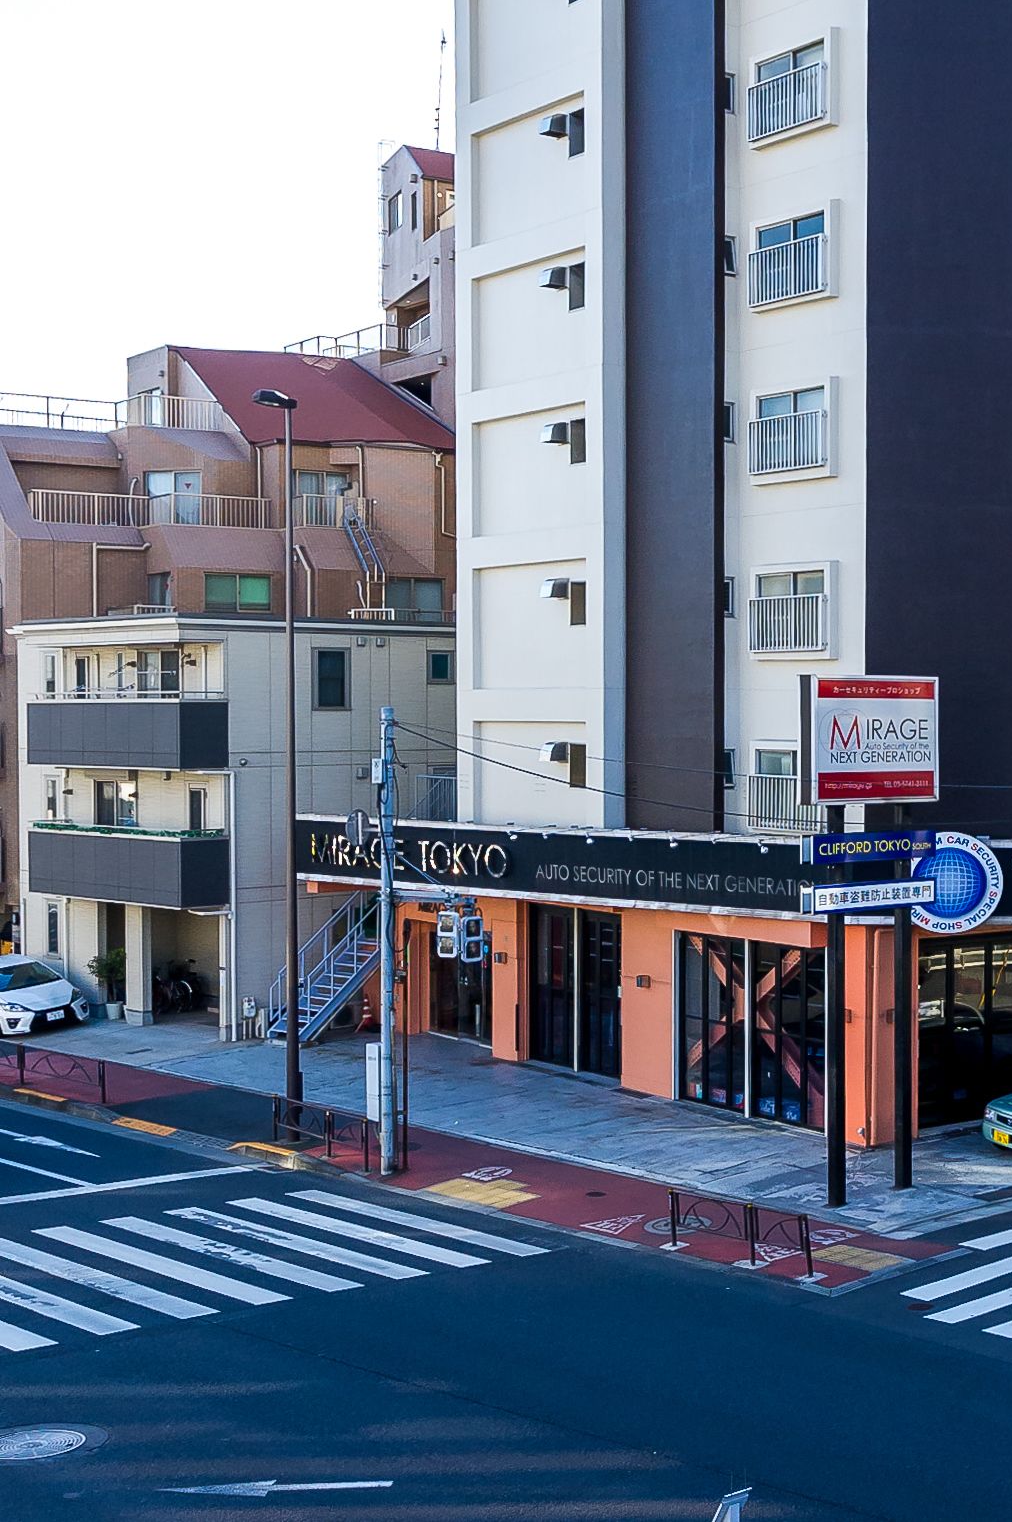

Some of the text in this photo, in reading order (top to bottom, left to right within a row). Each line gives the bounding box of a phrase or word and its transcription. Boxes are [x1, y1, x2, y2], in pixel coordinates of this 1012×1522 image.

[829, 714, 929, 750] MIRAGE
[830, 750, 931, 764] NEXT GENERATION
[864, 742, 881, 750] Auto
[882, 742, 909, 752] Security
[818, 838, 932, 856] CLIFFORD TOKYO SOUTH
[946, 835, 970, 848] CAR
[417, 839, 508, 878] TOKYO
[970, 842, 1000, 889] SECURITY
[536, 864, 814, 897] AUTO SECURITY OF THE NEXT GENERATIO
[818, 885, 932, 907] 自動車盗難防止装置専門
[963, 890, 998, 926] SPECIAL
[931, 921, 963, 931] SHOP
